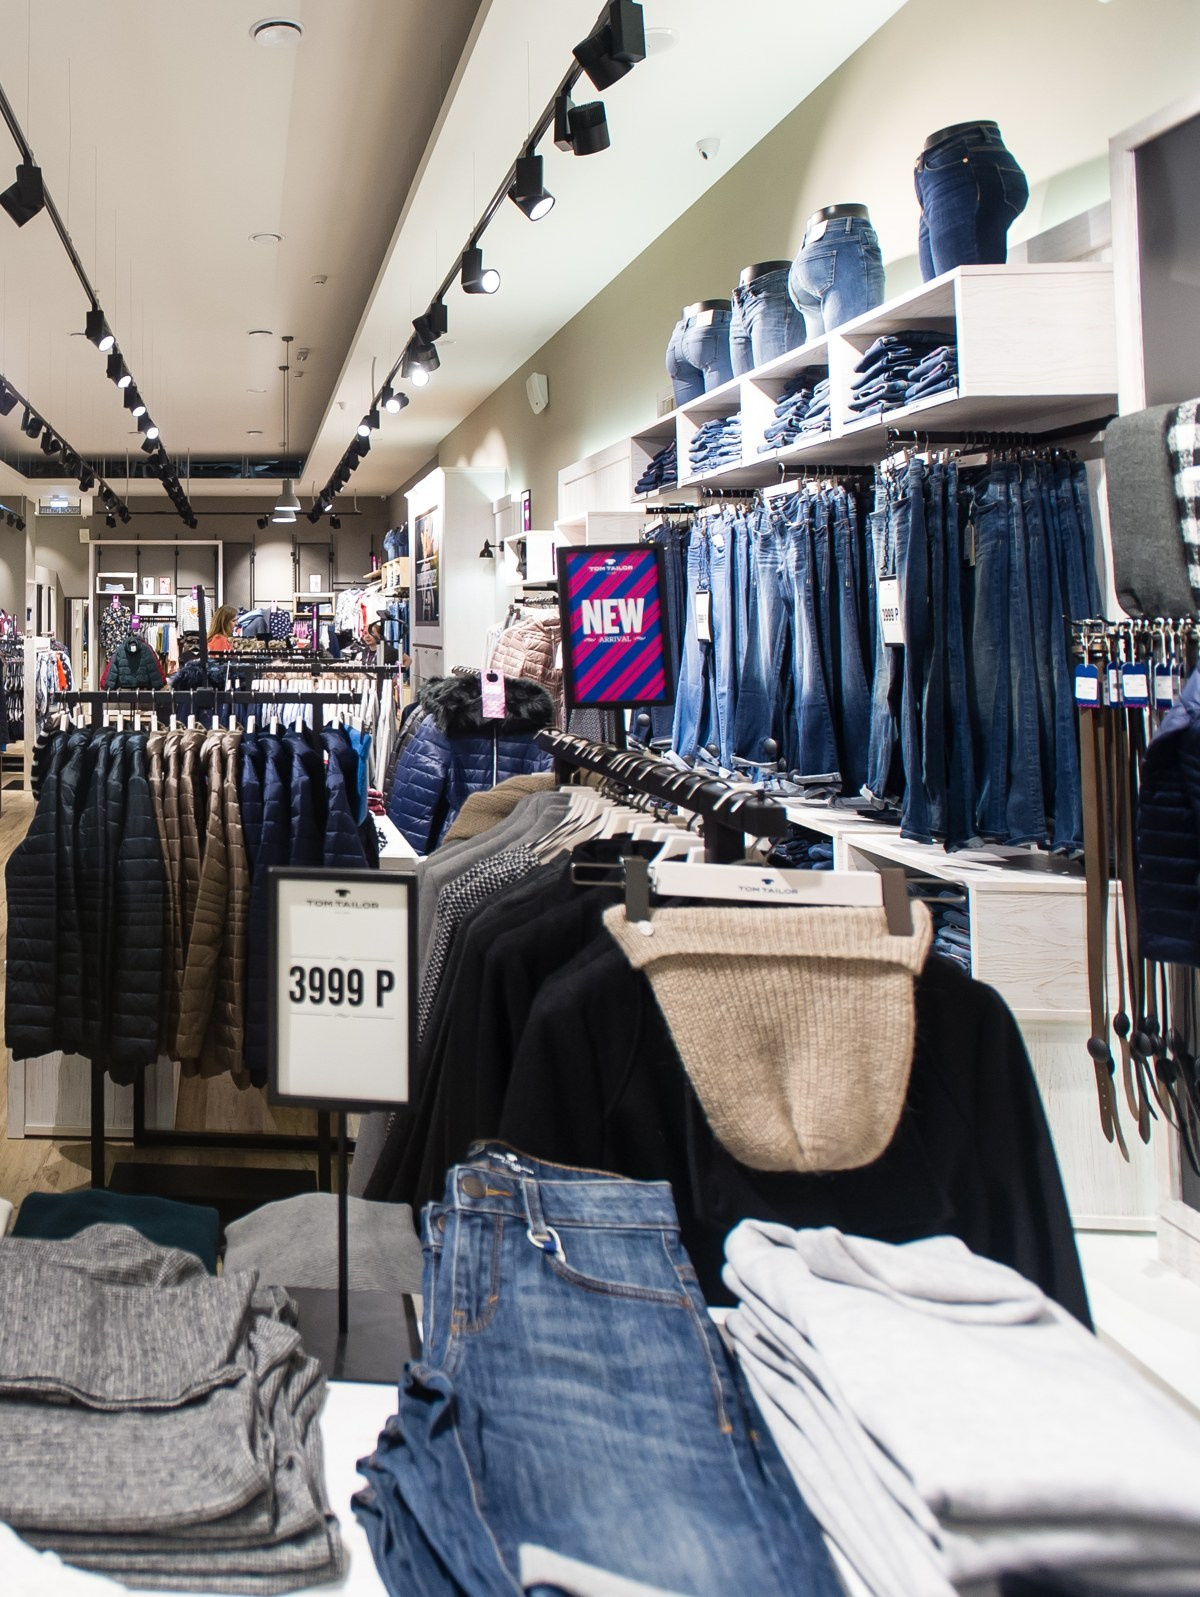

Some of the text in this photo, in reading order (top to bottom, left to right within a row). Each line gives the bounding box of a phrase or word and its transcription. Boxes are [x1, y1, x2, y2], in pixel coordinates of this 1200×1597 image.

[582, 598, 644, 635] NEW
[599, 635, 632, 643] ARRIVAL
[761, 887, 798, 895] TAILOR
[305, 899, 379, 909] TOM TAILOR
[288, 965, 396, 1009] 3999 P
